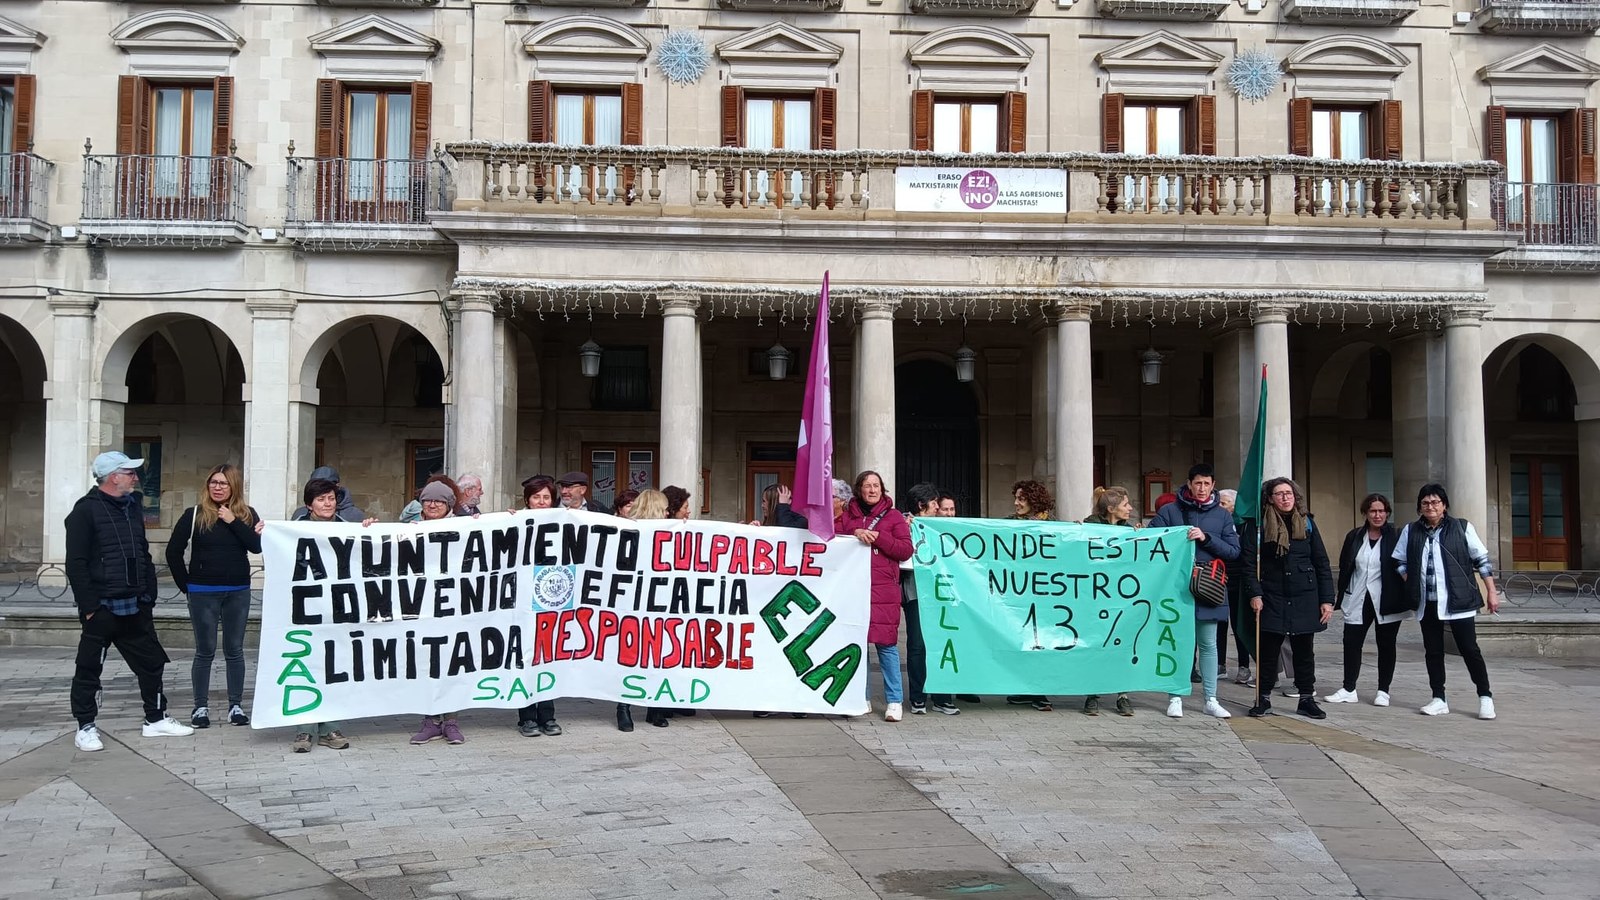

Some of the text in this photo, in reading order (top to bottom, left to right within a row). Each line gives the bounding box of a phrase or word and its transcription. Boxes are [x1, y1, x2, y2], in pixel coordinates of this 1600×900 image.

[937, 173, 962, 181] ERASO
[968, 176, 990, 188] EZ!
[651, 530, 827, 577] CULPABLE
[988, 568, 1140, 600] NUESTRO
[292, 570, 749, 625] CONVENIO EFICACIA
[933, 573, 960, 674] ELA
[324, 607, 755, 685] LIMITADA RESPONSABLE
[759, 579, 862, 707] ELA
[1155, 598, 1181, 678] SAD
[276, 629, 323, 716] SAD
